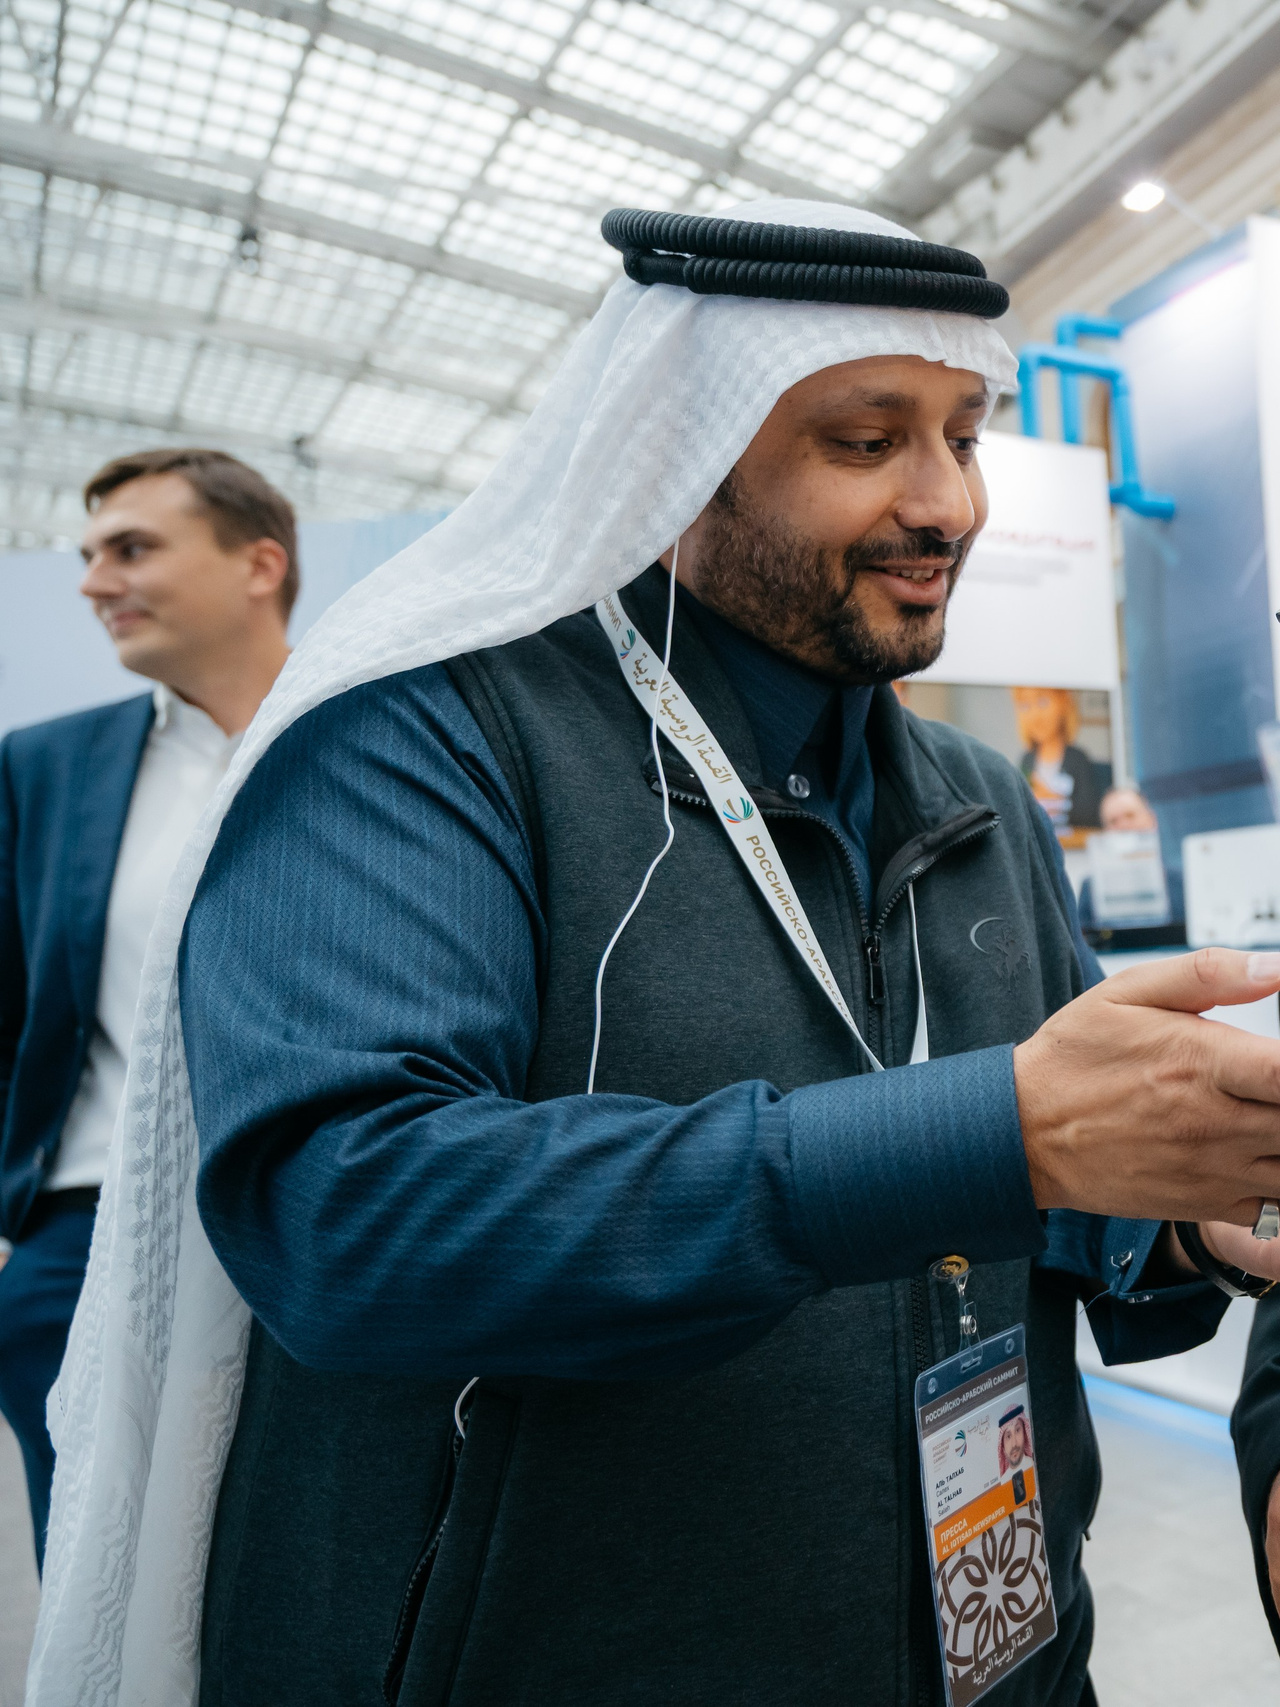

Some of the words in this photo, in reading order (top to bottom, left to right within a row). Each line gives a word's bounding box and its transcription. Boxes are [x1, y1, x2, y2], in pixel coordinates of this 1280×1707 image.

[659, 693, 708, 748] الروسية
[697, 745, 733, 785] القمة
[925, 1377, 993, 1424] РОССИЙСКО-АРАБСКИЙ
[992, 1366, 1019, 1387] САММИТ
[935, 1479, 946, 1490] АЛЬ
[945, 1466, 965, 1483] ТАЛХАБ
[937, 1500, 944, 1509] AL
[943, 1487, 963, 1504] TALHAB
[940, 1517, 968, 1544] ПРЕССА
[942, 1544, 950, 1555] AL
[972, 1505, 1006, 1534] NEWSPAPER
[1016, 1624, 1034, 1647] القمة
[993, 1638, 1017, 1667] الروسية
[972, 1657, 994, 1686] العربية
